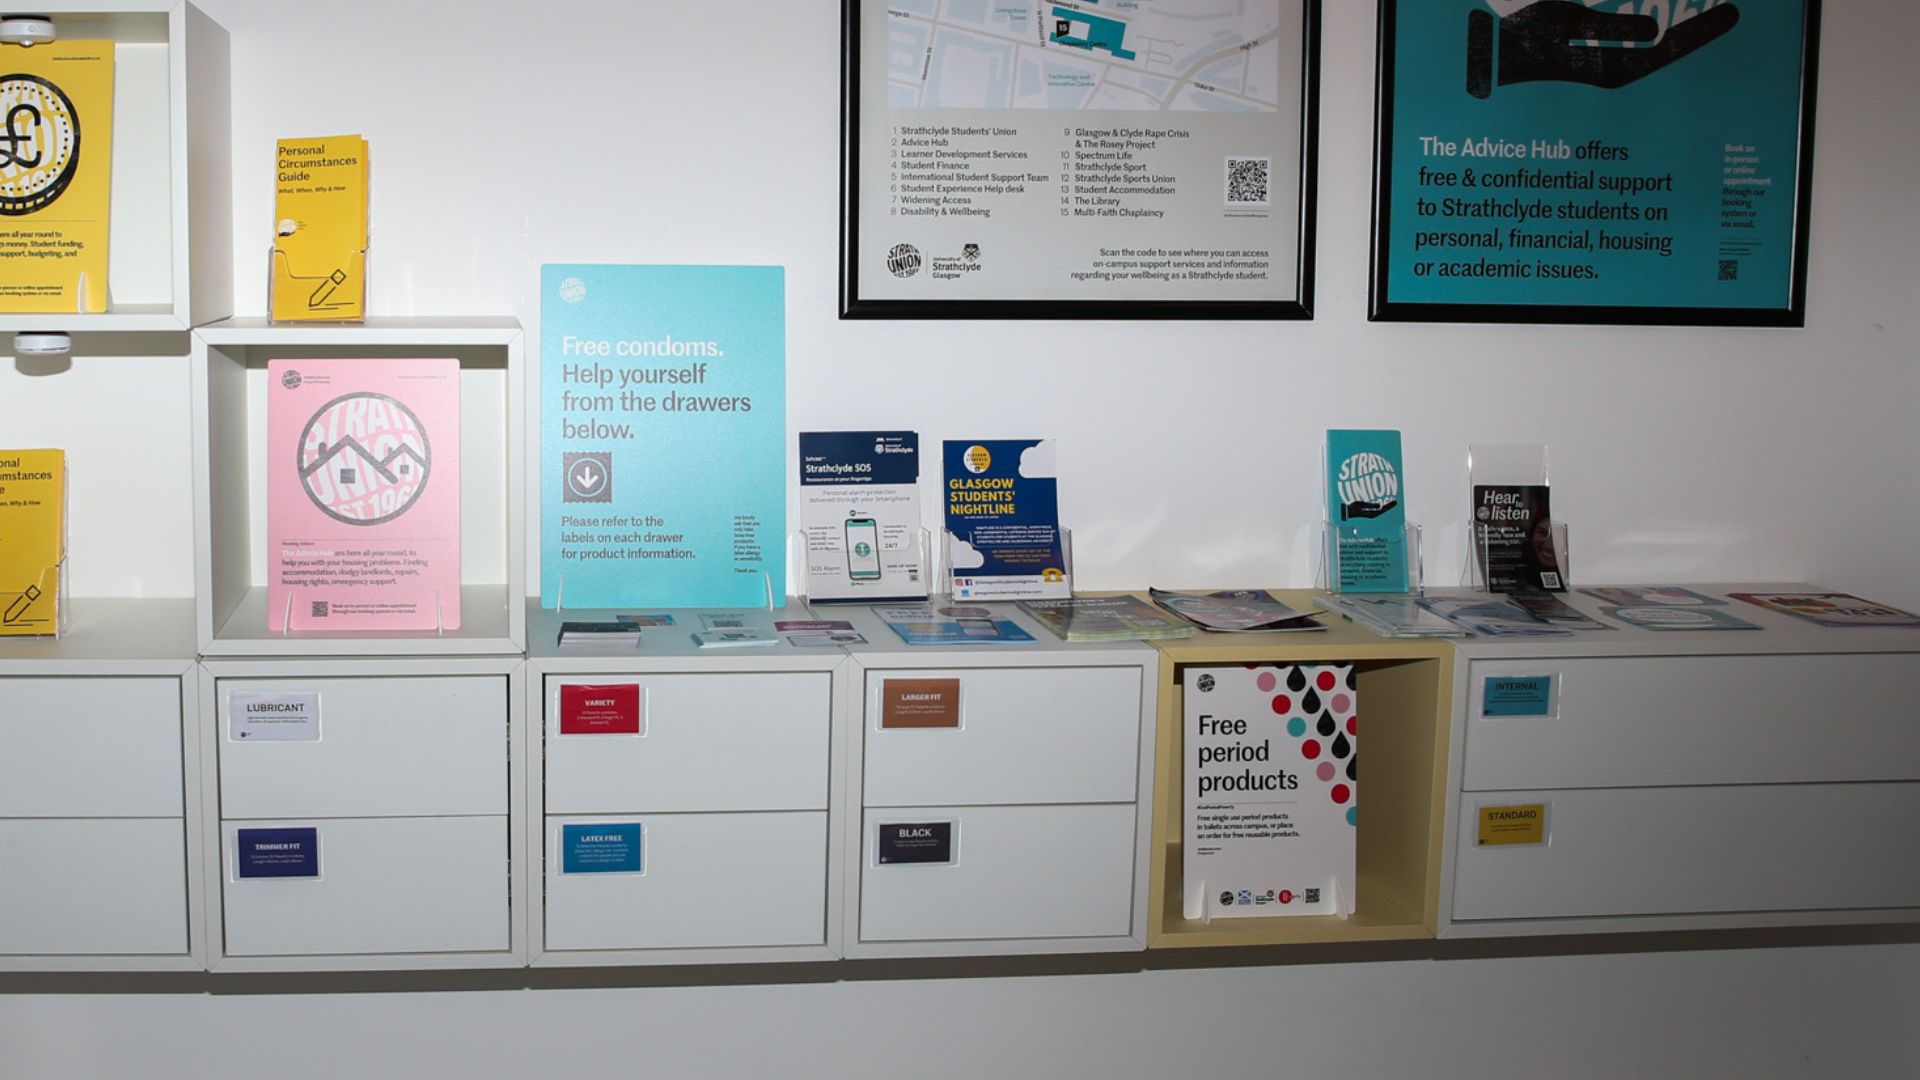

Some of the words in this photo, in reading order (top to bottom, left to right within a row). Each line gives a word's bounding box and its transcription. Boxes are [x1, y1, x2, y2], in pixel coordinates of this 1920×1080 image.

[901, 127, 949, 137] Strathclyde
[1076, 129, 1110, 138] Glasgow
[1120, 129, 1143, 139] Clyde
[1145, 130, 1165, 139] Rape
[279, 145, 324, 156] Personal
[1101, 141, 1124, 150] Rosey
[1126, 141, 1155, 150] Project
[1420, 137, 1456, 157] The
[1462, 138, 1526, 158] Advice
[1532, 139, 1570, 159] Hub
[1576, 140, 1628, 160] offers
[936, 151, 990, 160] Development
[1075, 152, 1114, 161] Spectrum
[279, 156, 357, 169] Circumstances
[1075, 163, 1121, 172] Strathclyde
[1123, 164, 1146, 173] Sport
[279, 171, 309, 182] Guide
[901, 173, 954, 181] International
[991, 174, 1024, 183] Support
[1075, 175, 1121, 184] Strathclyde
[1123, 175, 1150, 184] Sports
[1419, 168, 1456, 187] free
[1462, 168, 1476, 187] &
[1482, 169, 1593, 189] confidential
[1599, 171, 1672, 196] support
[936, 185, 982, 194] Experience
[985, 186, 1003, 194] Help
[901, 197, 940, 205] Widening
[1092, 198, 1120, 207] Library
[901, 208, 939, 217] Disability
[949, 209, 990, 217] Wellbeing
[1119, 209, 1164, 218] Chaplaincy
[1418, 199, 1436, 216] to
[1442, 199, 1552, 223] Strathclyde
[1557, 201, 1639, 220] students
[1645, 207, 1668, 221] on
[1416, 229, 1503, 253] personal,
[1510, 231, 1594, 251] financial,
[1599, 232, 1672, 256] housing
[888, 255, 920, 273] UNION
[933, 263, 981, 273] Strathclyde
[1140, 261, 1170, 269] support
[1414, 263, 1433, 277] or
[1439, 260, 1531, 278] academic
[1536, 261, 1599, 279] issues.
[1071, 272, 1110, 280] regarding
[1131, 272, 1169, 281] wellbeing
[1188, 272, 1233, 281] Strathclyde
[562, 336, 610, 356] Free
[617, 336, 724, 356] condoms.
[562, 364, 613, 389] Help
[620, 364, 706, 389] yourself
[562, 391, 614, 411] from
[620, 391, 656, 411] the
[662, 391, 751, 411] drawers
[562, 419, 634, 439] below.
[806, 464, 853, 473] Strathclyde
[855, 464, 871, 472] SOS
[1339, 453, 1394, 480] STRATH
[950, 478, 1014, 489] GLASGOW
[1338, 472, 1397, 504] UNION
[951, 491, 1015, 501] STUDENTS'
[1484, 490, 1519, 504] Hear
[951, 504, 1015, 514] NIGHTLINE
[1491, 505, 1530, 520] listen
[561, 516, 598, 526] Please
[602, 516, 628, 526] refer
[632, 516, 642, 526] to
[646, 516, 663, 526] the
[561, 532, 594, 543] labels
[614, 532, 640, 542] each
[644, 532, 683, 542] drawer
[562, 549, 576, 559] for
[580, 549, 624, 562] product
[628, 548, 695, 559] information.
[1495, 682, 1538, 690] INTERNAL
[247, 704, 305, 712] LUBRICANT
[1199, 716, 1246, 735] Free
[1199, 740, 1269, 768] period
[1199, 769, 1298, 797] products
[1488, 810, 1536, 820] STANDARD
[900, 829, 931, 837] BLACK
